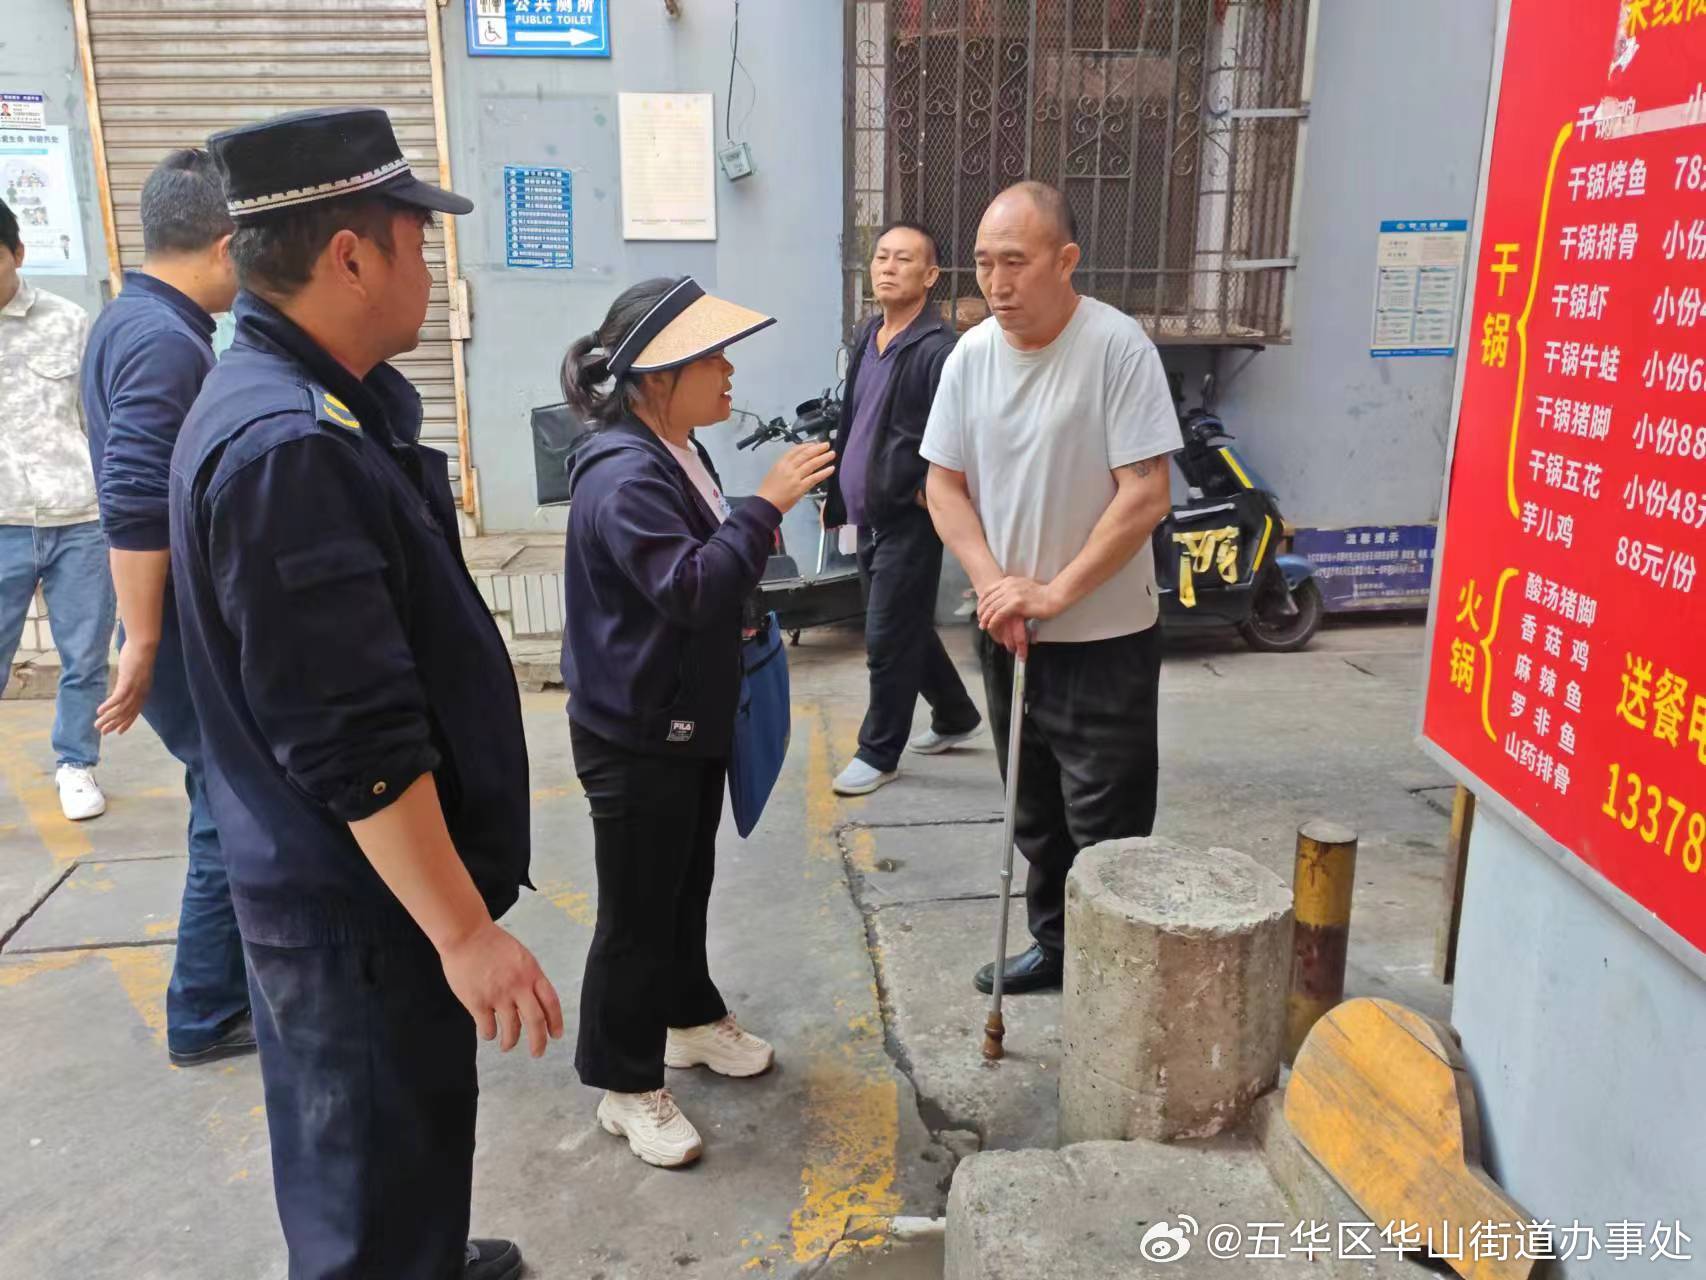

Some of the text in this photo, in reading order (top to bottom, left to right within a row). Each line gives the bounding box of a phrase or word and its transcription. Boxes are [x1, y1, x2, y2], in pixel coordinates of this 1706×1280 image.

[514, 15, 593, 25] PUBLIC TOILET
[1567, 154, 1706, 202] 干锅烤鱼 78
[1559, 222, 1639, 261] 干锅排骨
[1480, 242, 1521, 369] 干锅
[1551, 283, 1706, 328] 干锅虾 小份
[1543, 340, 1706, 393] 干锅牛蛙 小份6
[1535, 394, 1614, 441] 干锅猪脚
[1528, 448, 1604, 501] 干锅五花
[1520, 500, 1697, 594] 芋儿鸡 88元/份
[1524, 571, 1598, 630] 酸汤猪脚
[1448, 577, 1484, 695] 火锅
[673, 722, 691, 731] FILA
[1504, 730, 1571, 797] 山药排骨
[1601, 762, 1706, 874] 13378
